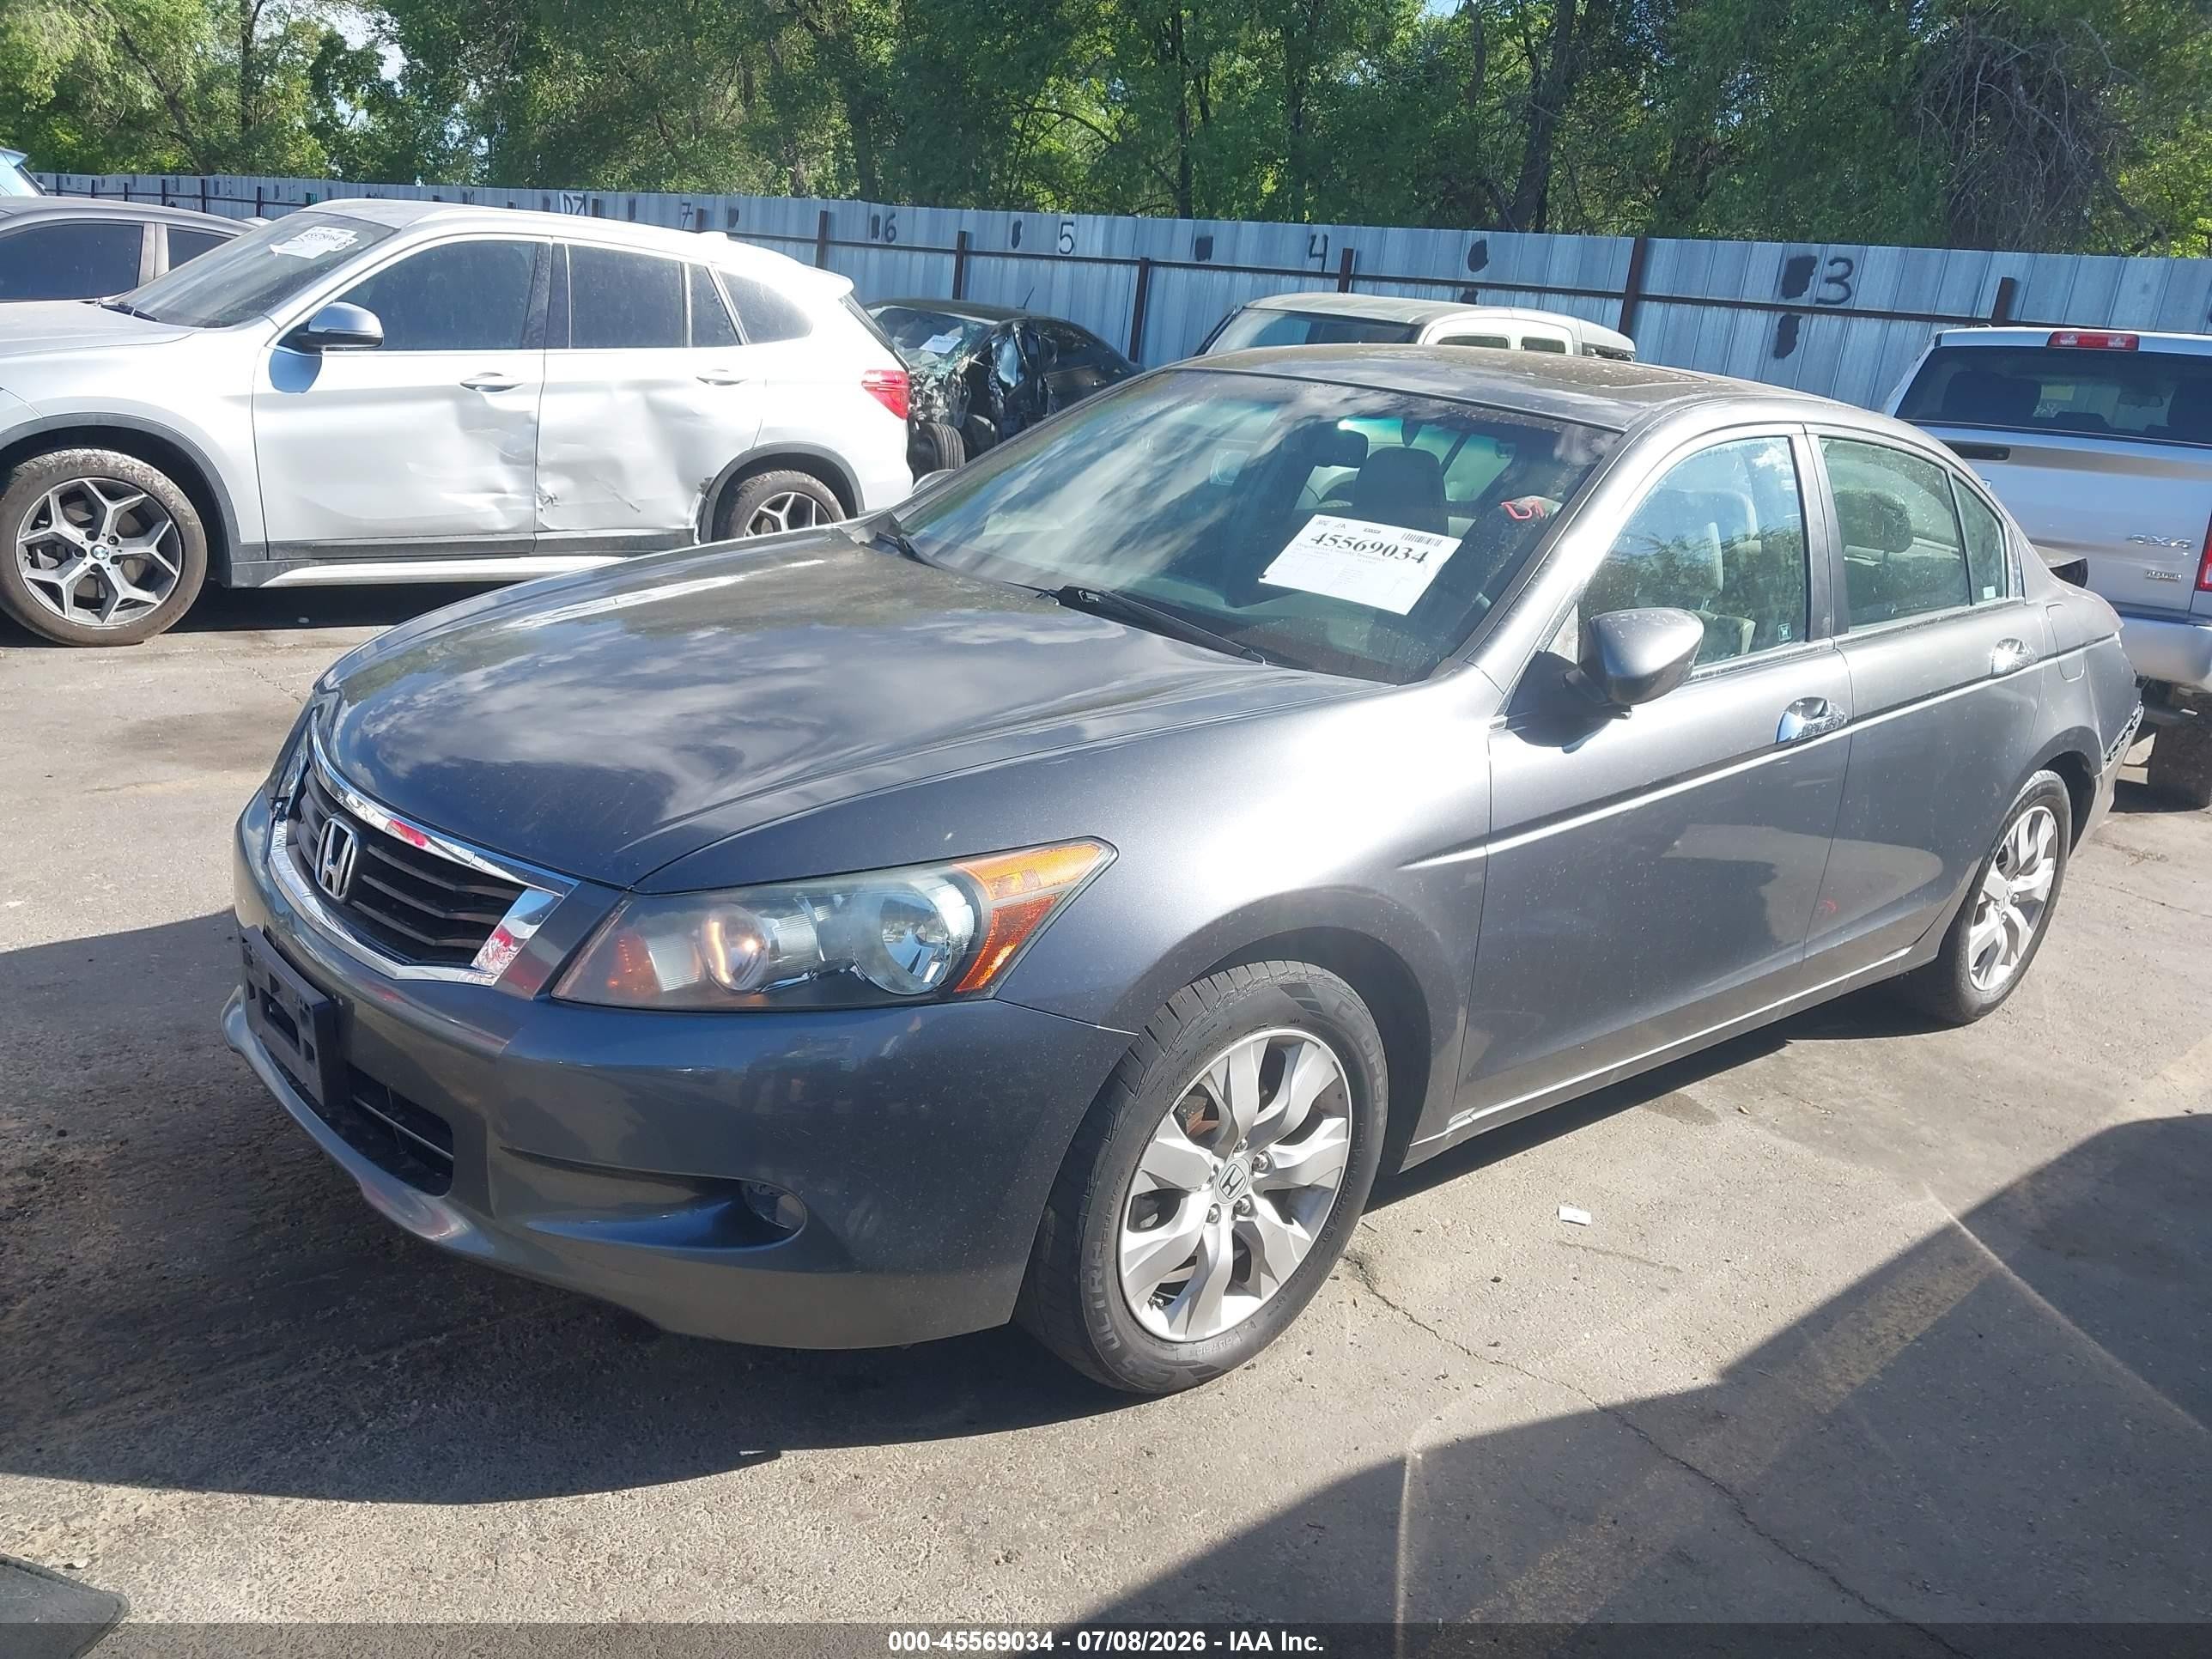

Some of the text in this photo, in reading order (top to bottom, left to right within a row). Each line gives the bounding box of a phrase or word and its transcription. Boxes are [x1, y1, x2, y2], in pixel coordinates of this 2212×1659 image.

[1058, 222, 1074, 254] 5
[1309, 234, 1328, 272] 4
[1815, 256, 1853, 305] 3
[1310, 532, 1429, 564] 45569034
